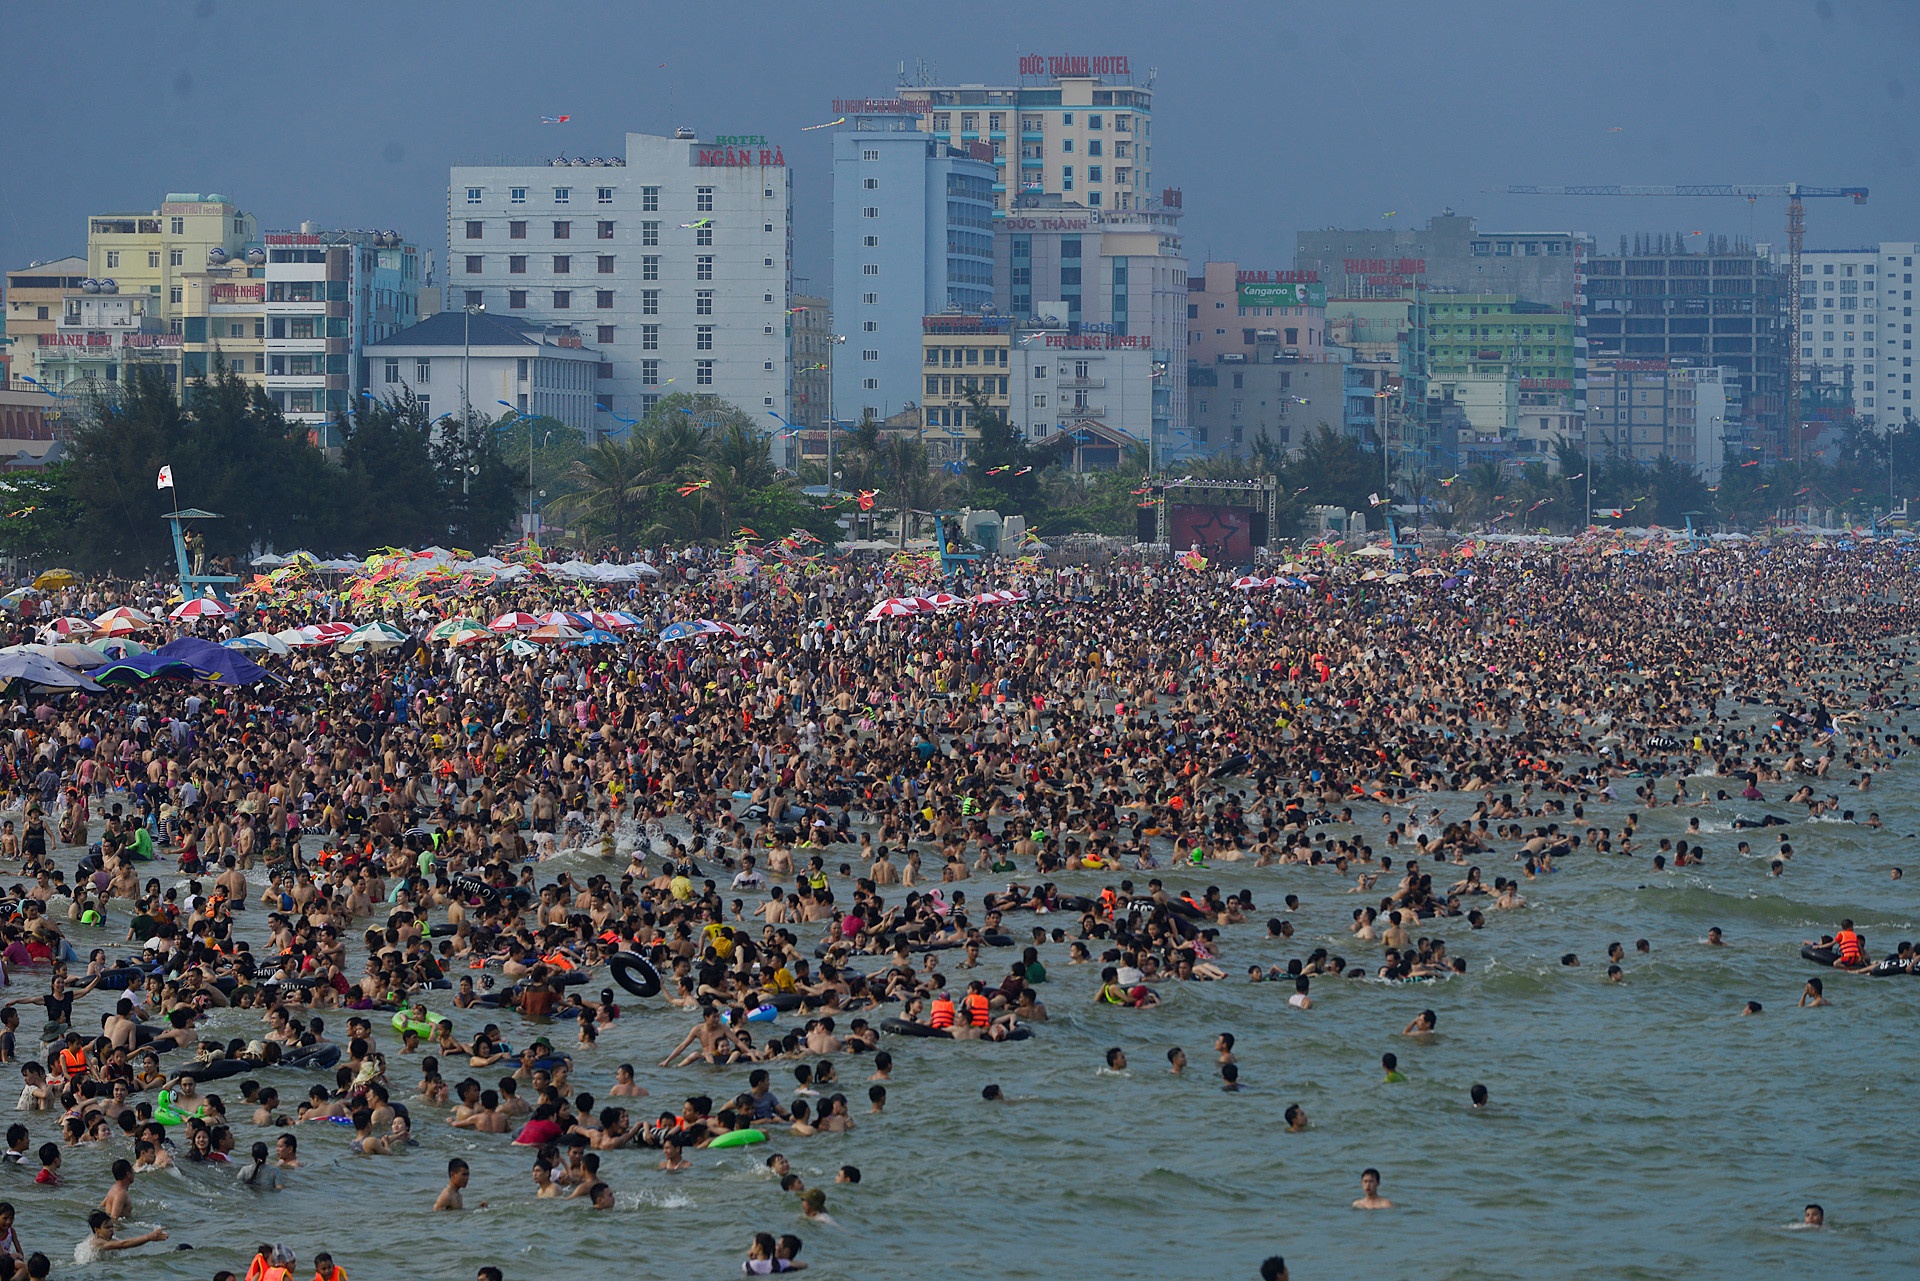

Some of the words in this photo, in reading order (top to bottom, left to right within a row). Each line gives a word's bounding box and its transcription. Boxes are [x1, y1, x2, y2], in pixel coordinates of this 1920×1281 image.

[1019, 53, 1044, 74] ĐỨC
[1047, 52, 1089, 74] THÀNH
[1093, 56, 1130, 74] HOTEL
[716, 135, 768, 145] HOTEL
[699, 145, 751, 165] NGÂN
[759, 145, 785, 165] HÀ
[203, 206, 221, 214] Hotel
[1006, 217, 1036, 230] ĐỨC
[1041, 216, 1087, 230] THÀNH
[1241, 286, 1288, 297] Kangaroo
[1080, 321, 1119, 332] Hotel
[42, 334, 83, 346] THANH
[1105, 335, 1137, 347] LINH
